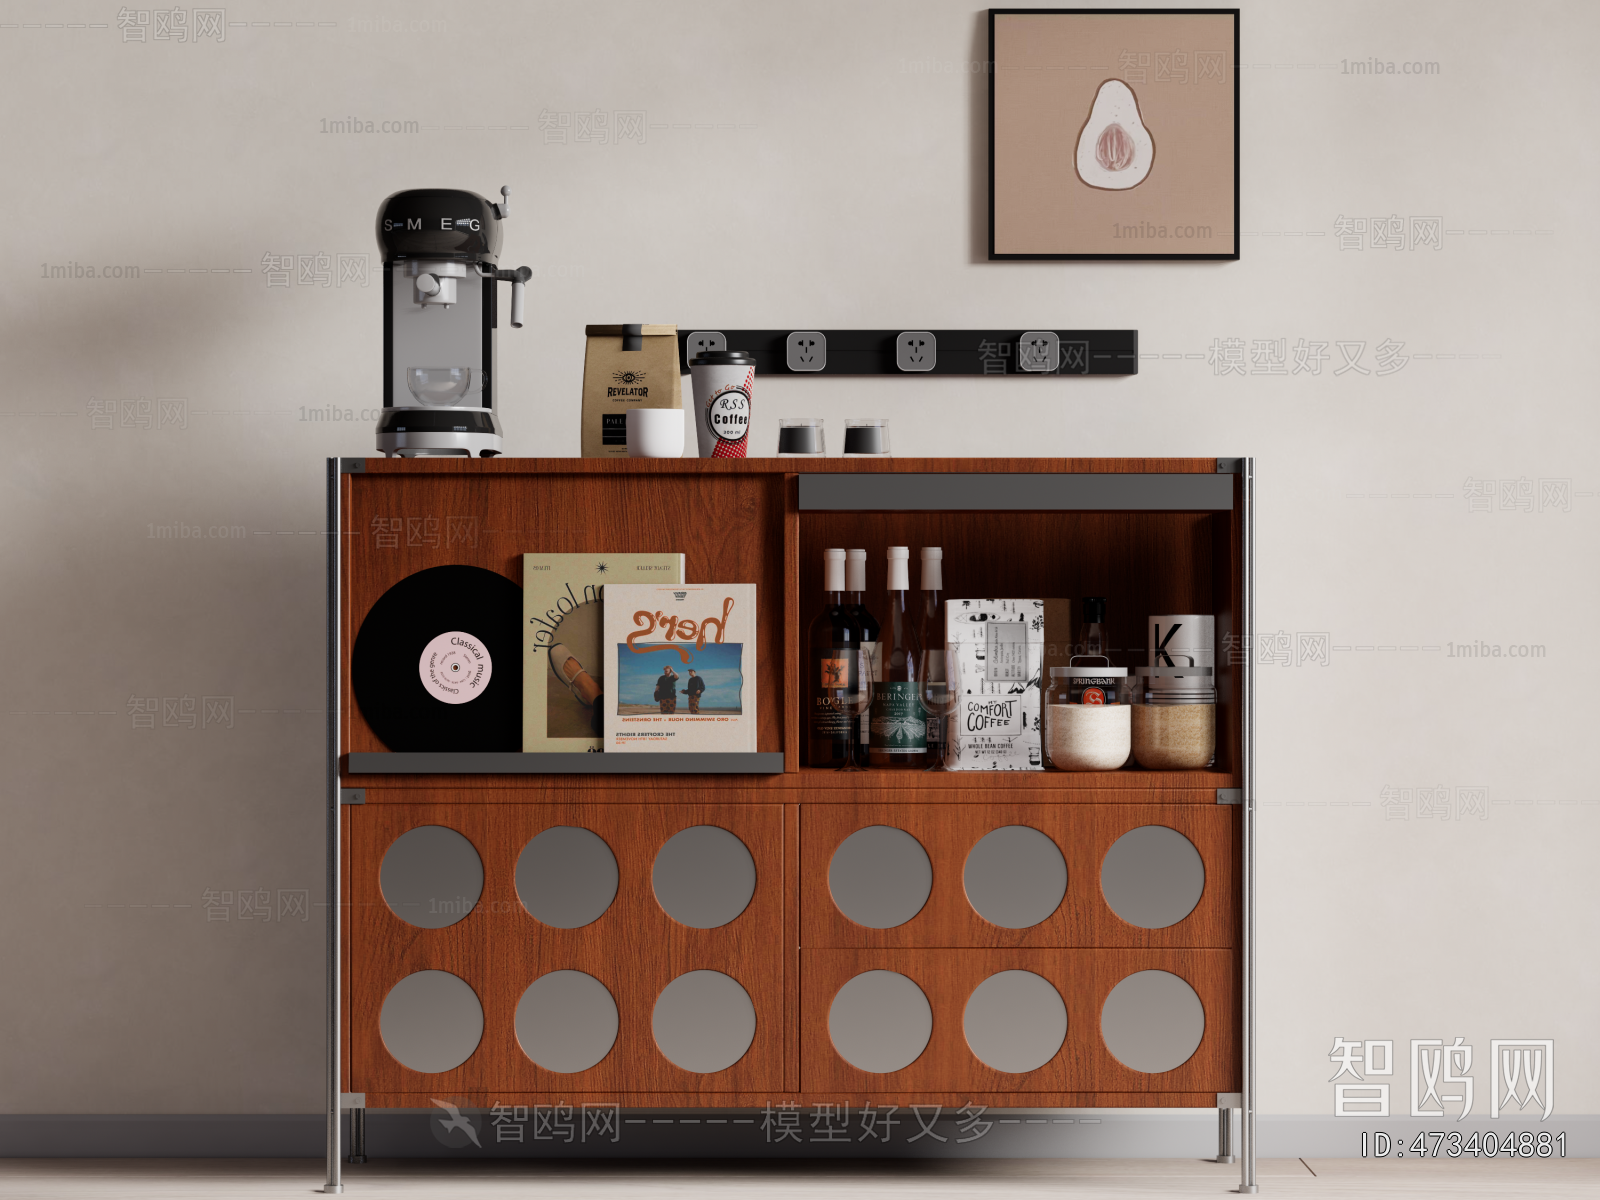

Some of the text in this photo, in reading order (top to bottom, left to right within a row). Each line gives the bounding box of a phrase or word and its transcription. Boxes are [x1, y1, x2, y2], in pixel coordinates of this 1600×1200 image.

[607, 387, 648, 397] REVELATOR
[714, 413, 748, 425] Coffee
[450, 636, 484, 660] Classical
[469, 663, 484, 689] music
[1072, 677, 1116, 685] SPRINGBANK
[816, 696, 854, 706] BOGLE
[876, 692, 922, 701] BERINGER
[968, 700, 1017, 718] COMFORT
[967, 712, 1011, 732] COFFEE
